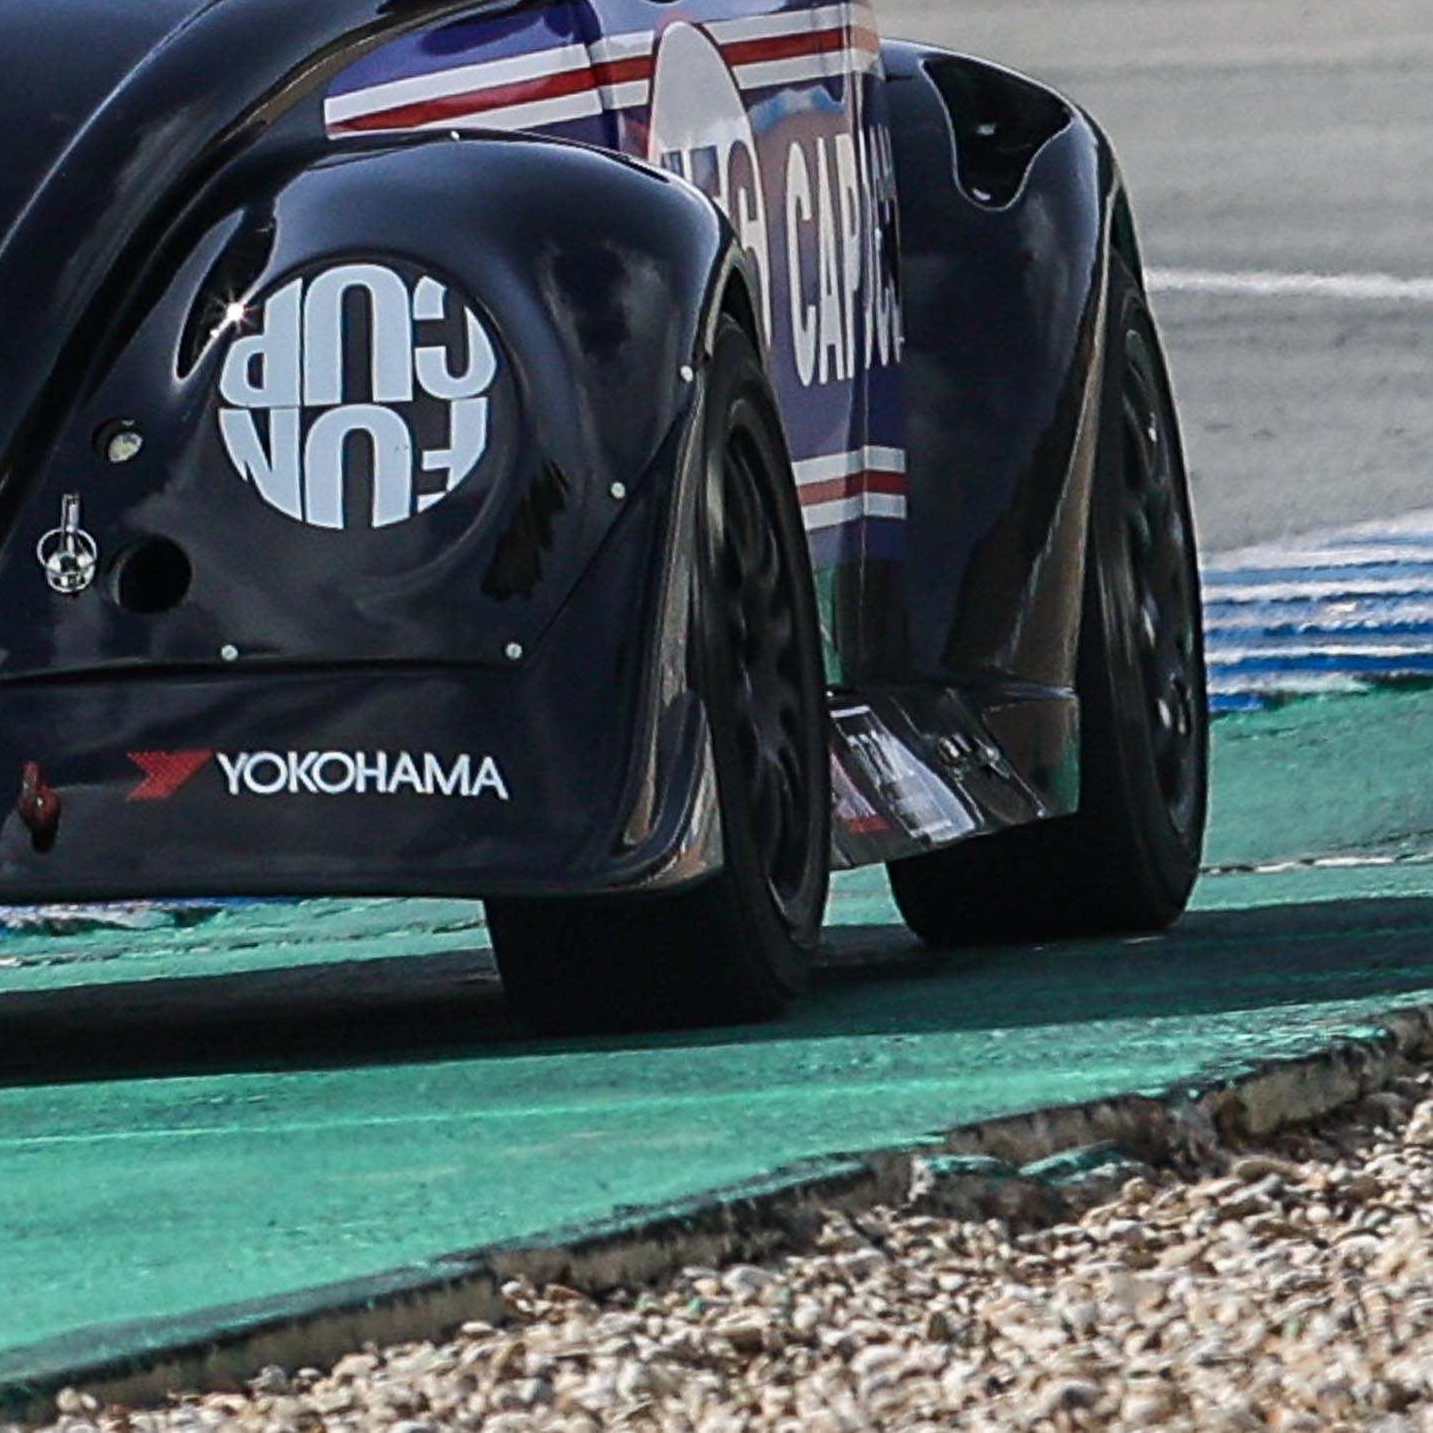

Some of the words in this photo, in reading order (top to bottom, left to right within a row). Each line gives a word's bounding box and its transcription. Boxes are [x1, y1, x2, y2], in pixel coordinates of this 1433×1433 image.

[219, 263, 497, 409] CUP
[218, 396, 489, 530] FUN
[216, 750, 509, 801] YOKOHAMA
